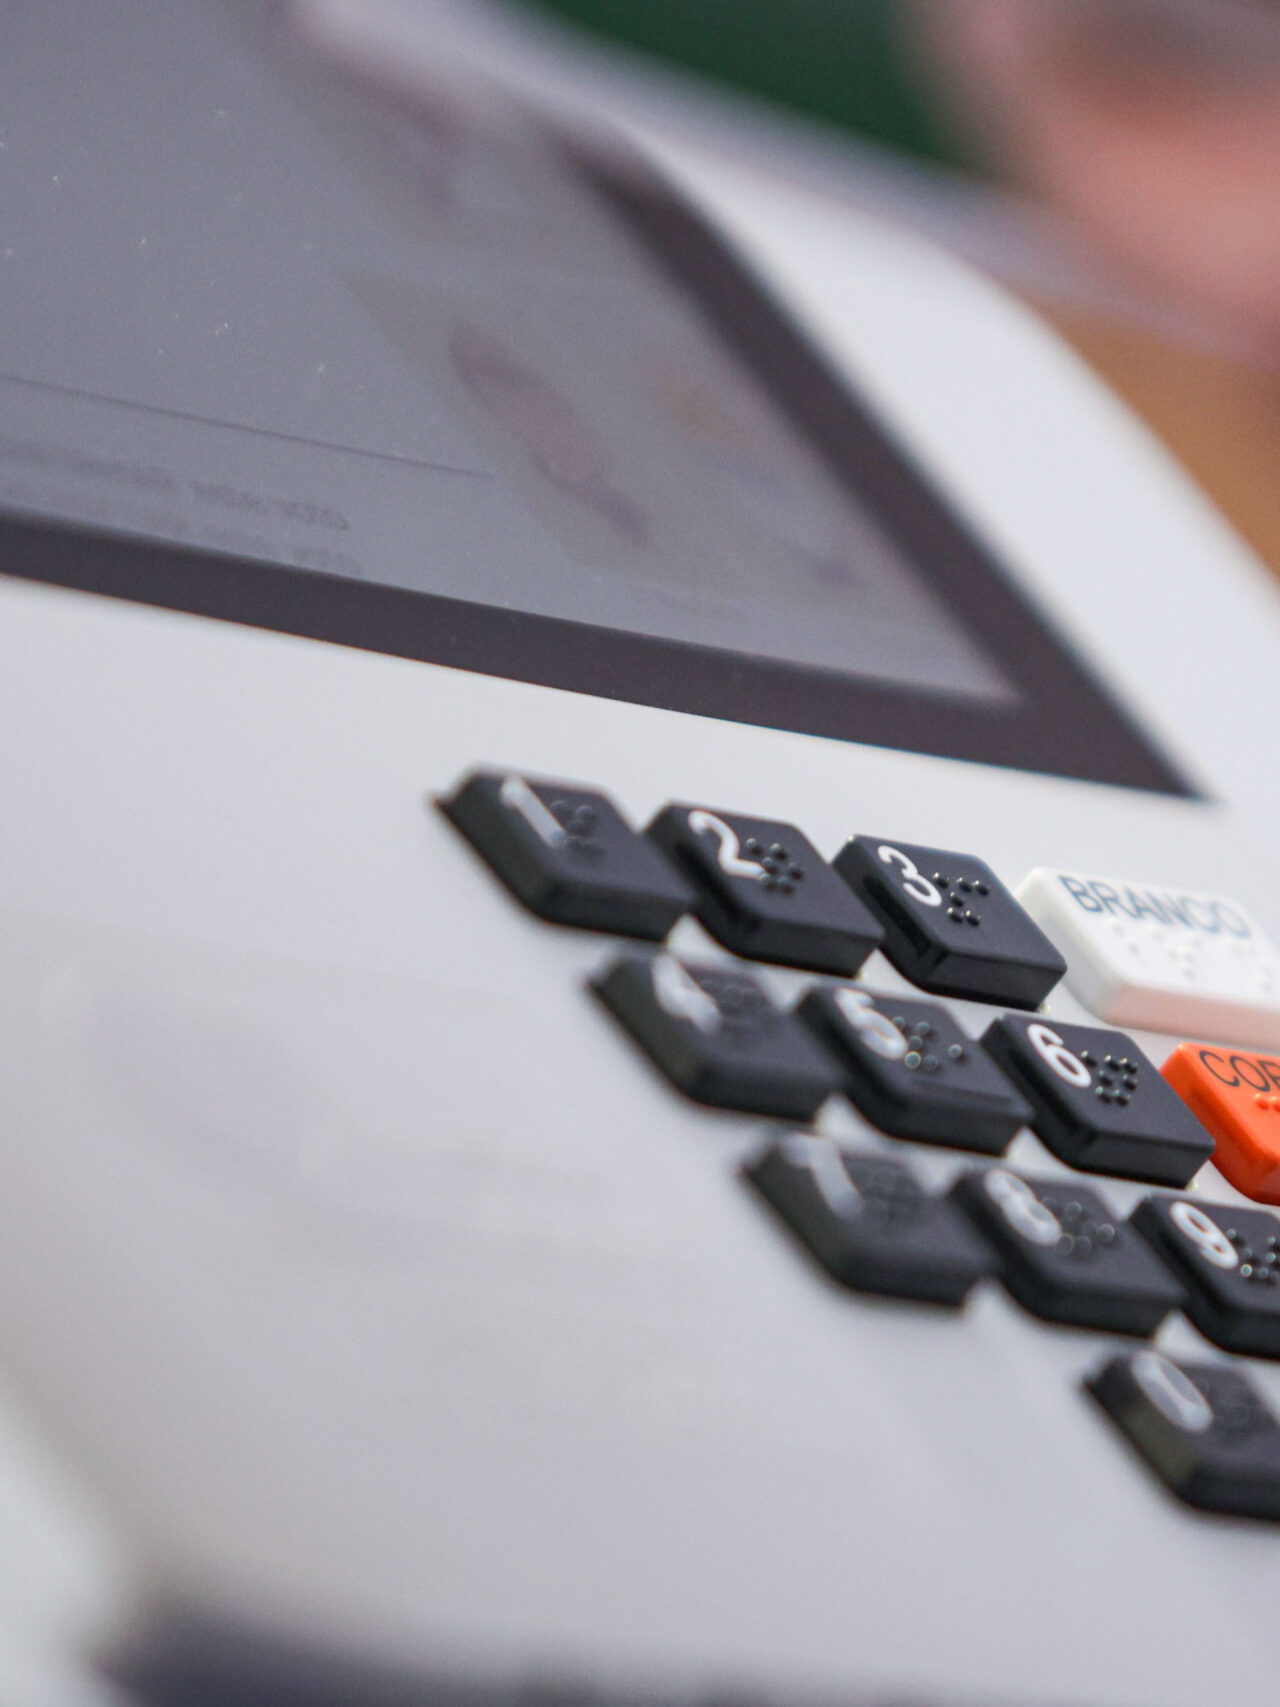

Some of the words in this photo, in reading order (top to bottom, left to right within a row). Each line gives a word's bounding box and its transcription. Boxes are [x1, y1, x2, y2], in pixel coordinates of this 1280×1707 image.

[502, 775, 566, 848] 1
[688, 810, 768, 880] 2
[877, 845, 942, 907] 3
[1057, 874, 1252, 939] BRANCO
[836, 988, 909, 1061] 5
[1027, 1023, 1092, 1088] 6
[985, 1169, 1063, 1246] 8
[1169, 1201, 1239, 1268] 9
[1131, 1350, 1214, 1432] 0
